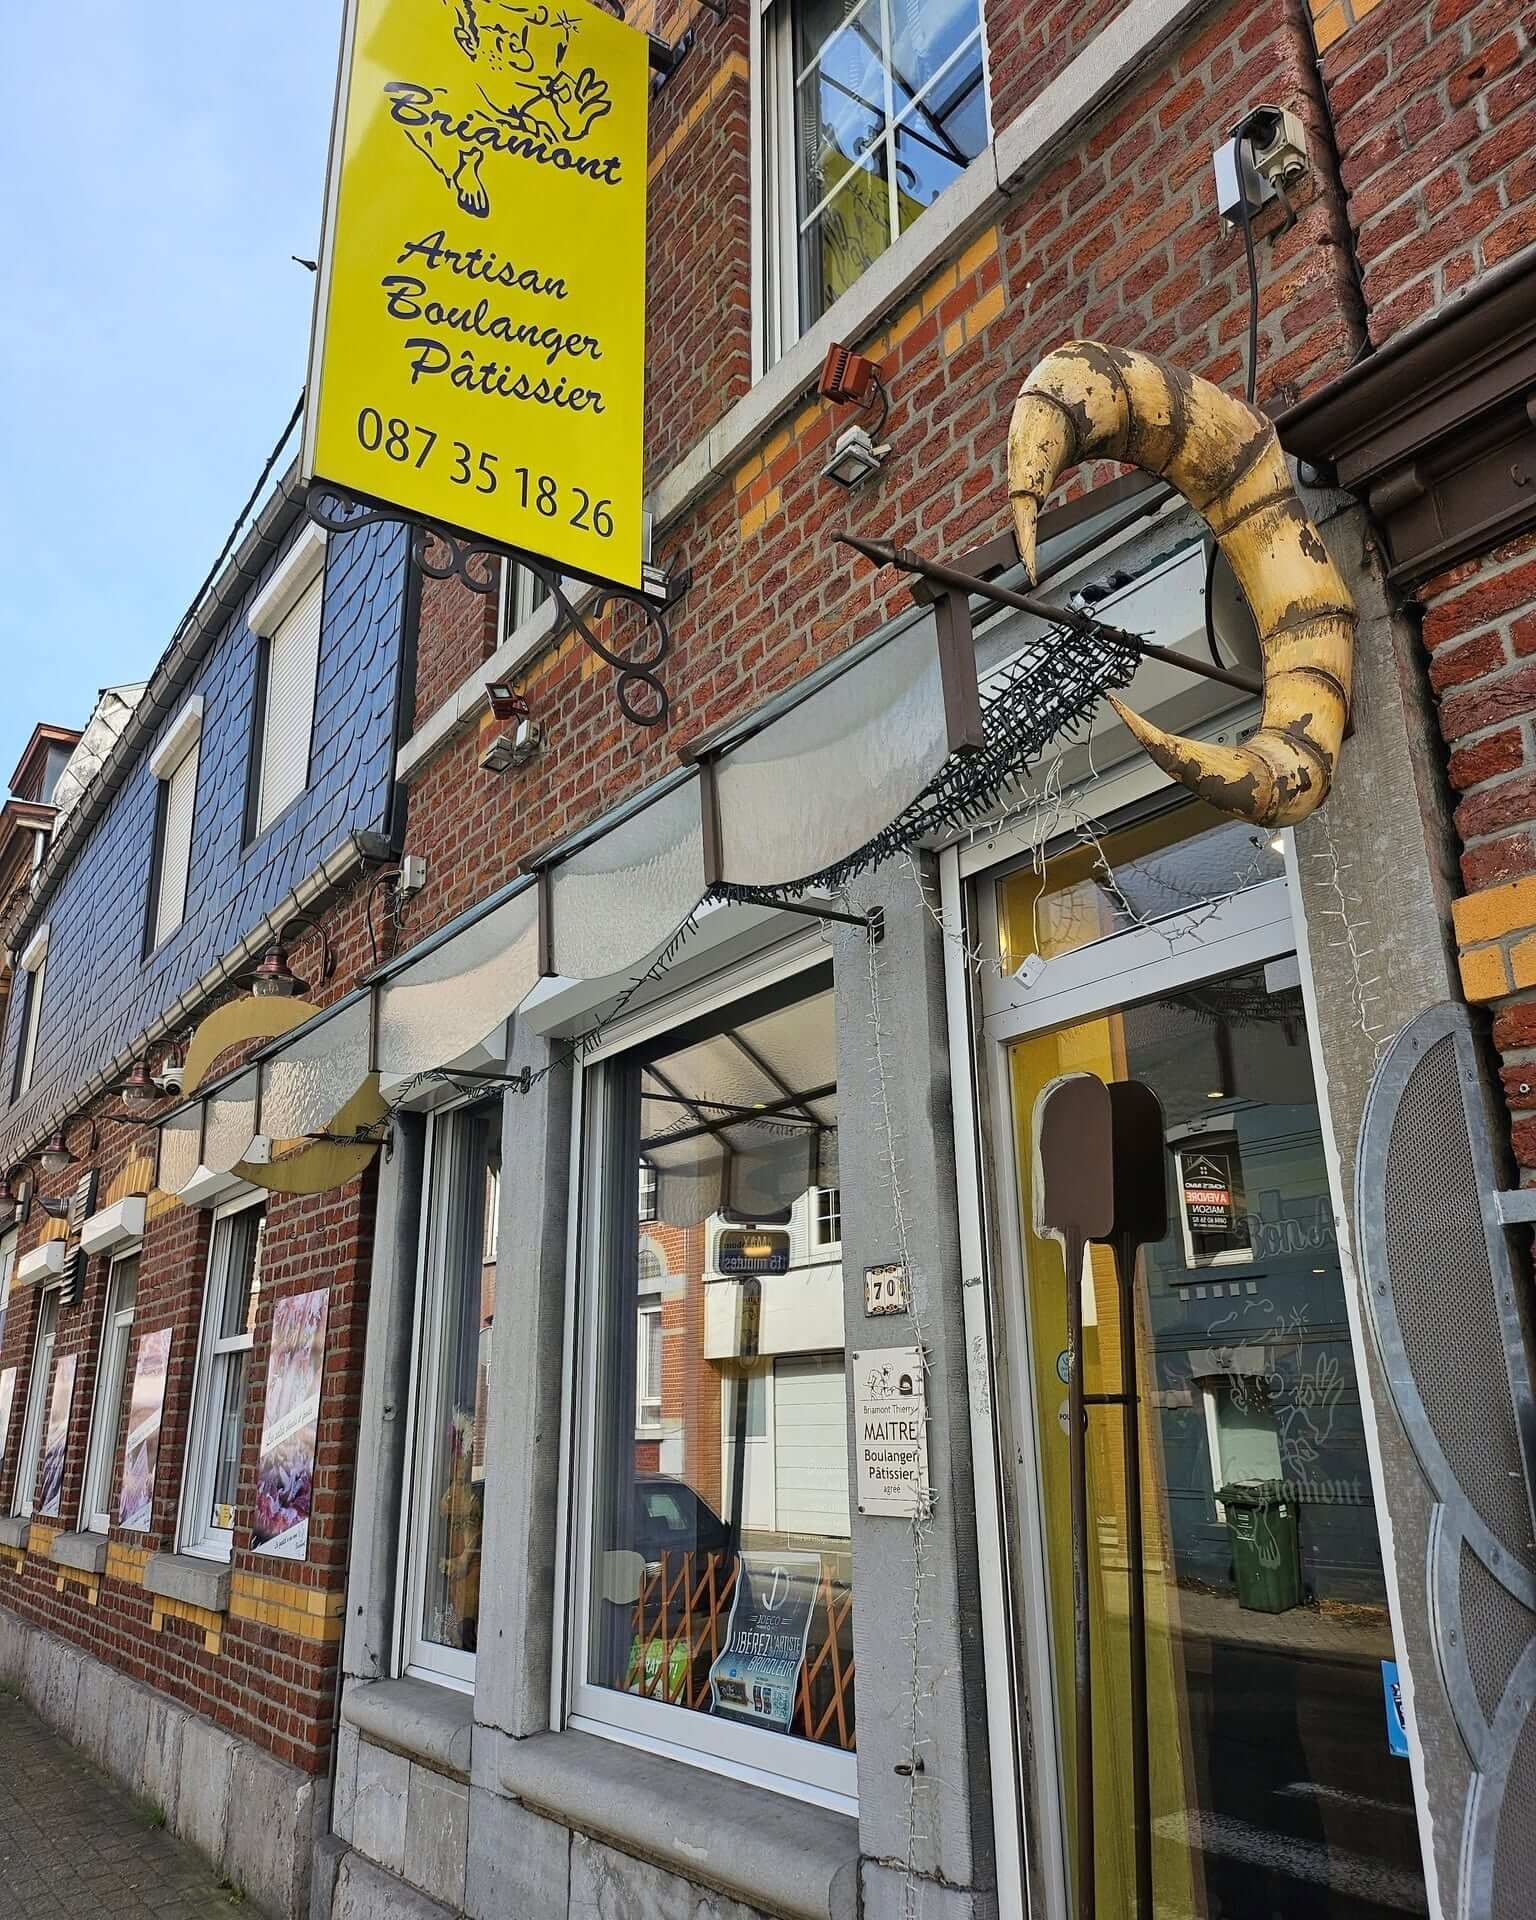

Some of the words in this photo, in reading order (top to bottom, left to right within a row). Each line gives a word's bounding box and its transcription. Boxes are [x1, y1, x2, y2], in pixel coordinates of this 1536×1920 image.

[384, 81, 623, 187] Briamont
[396, 229, 569, 300] Artisan
[381, 275, 604, 366] Boulanger
[404, 337, 606, 416] Pâtissier
[356, 406, 438, 471] 087
[450, 440, 499, 495] 35
[514, 467, 559, 518] 18
[568, 486, 615, 539] 26
[873, 1279, 896, 1300] 70
[864, 1421, 917, 1441] MAITRE
[864, 1449, 918, 1465] Boulanger
[869, 1466, 915, 1480] Pâtissier
[730, 1628, 771, 1657] LIBÉREZ
[747, 1655, 796, 1677] BRICOLEUR
